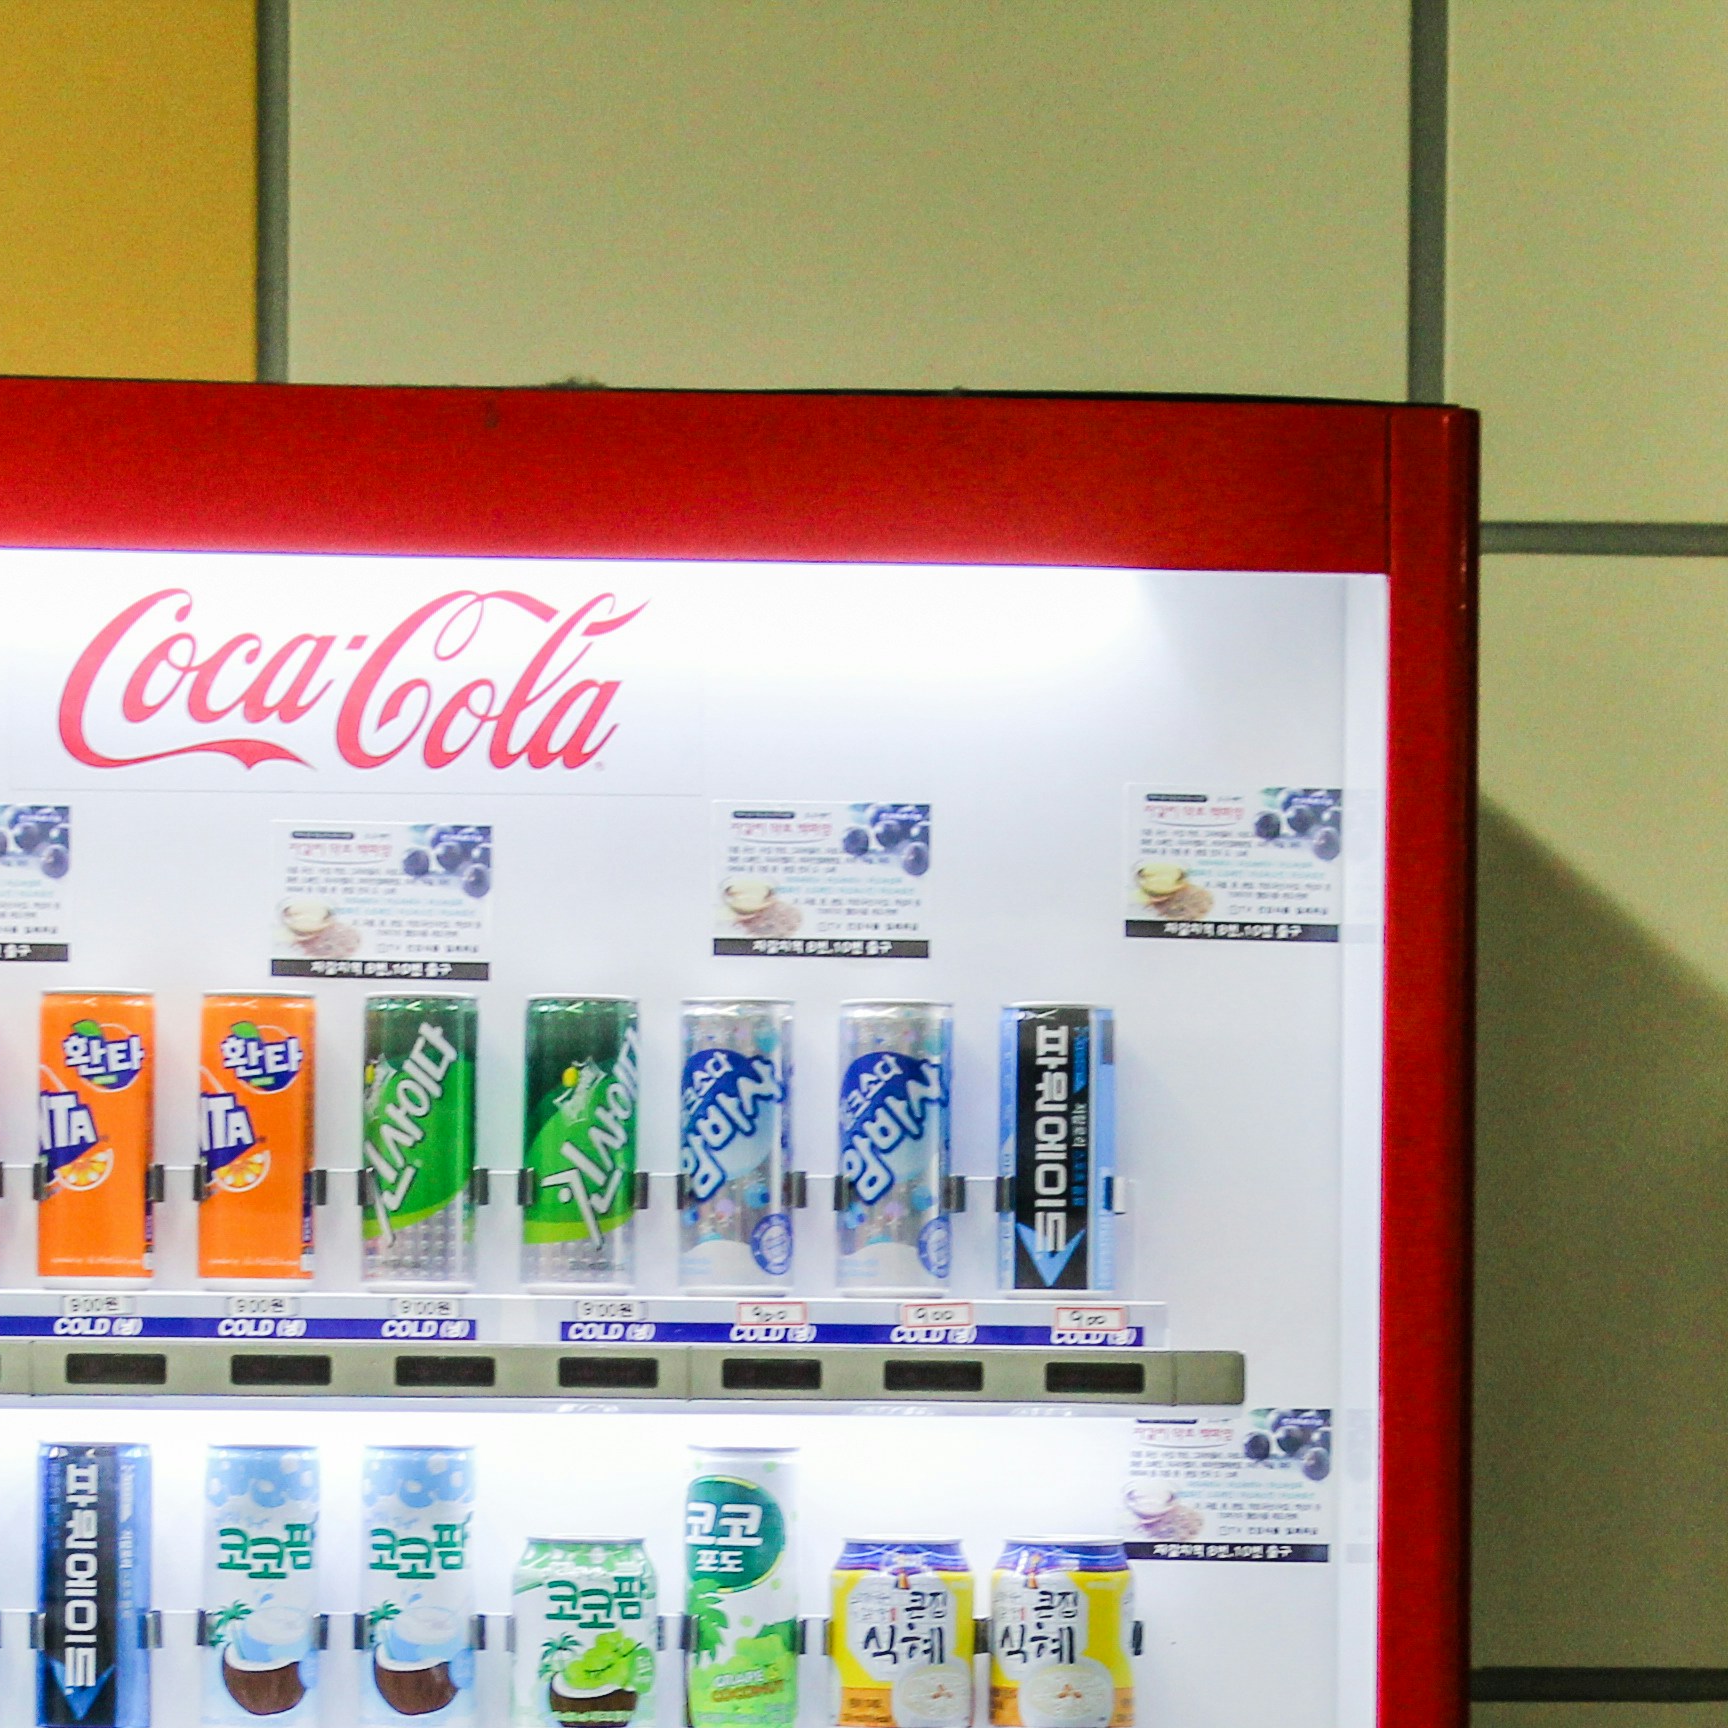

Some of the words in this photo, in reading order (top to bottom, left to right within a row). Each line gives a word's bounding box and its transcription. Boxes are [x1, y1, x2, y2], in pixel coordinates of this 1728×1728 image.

[58, 588, 650, 770] Coca-Cola
[63, 1034, 144, 1077] 환타
[222, 1034, 303, 1077] 환타
[842, 1062, 942, 1202] 암바사
[1034, 1025, 1069, 1252] 파워에이드
[53, 1315, 110, 1339] COLD
[217, 1316, 274, 1340] COLD
[380, 1317, 437, 1341] COLD
[566, 1324, 623, 1343] COLD
[685, 1501, 764, 1547] 코코
[217, 1514, 318, 1579] 코코팜
[370, 1514, 473, 1579] 코코팜
[695, 1549, 745, 1573] 포도
[64, 1464, 98, 1689] 파워에이드
[545, 1575, 654, 1629] 코코팜
[904, 1590, 948, 1620] 큰집
[1033, 1590, 1079, 1619] 큰집
[863, 1621, 946, 1665] 식혜
[1000, 1621, 1076, 1665] 식혜
